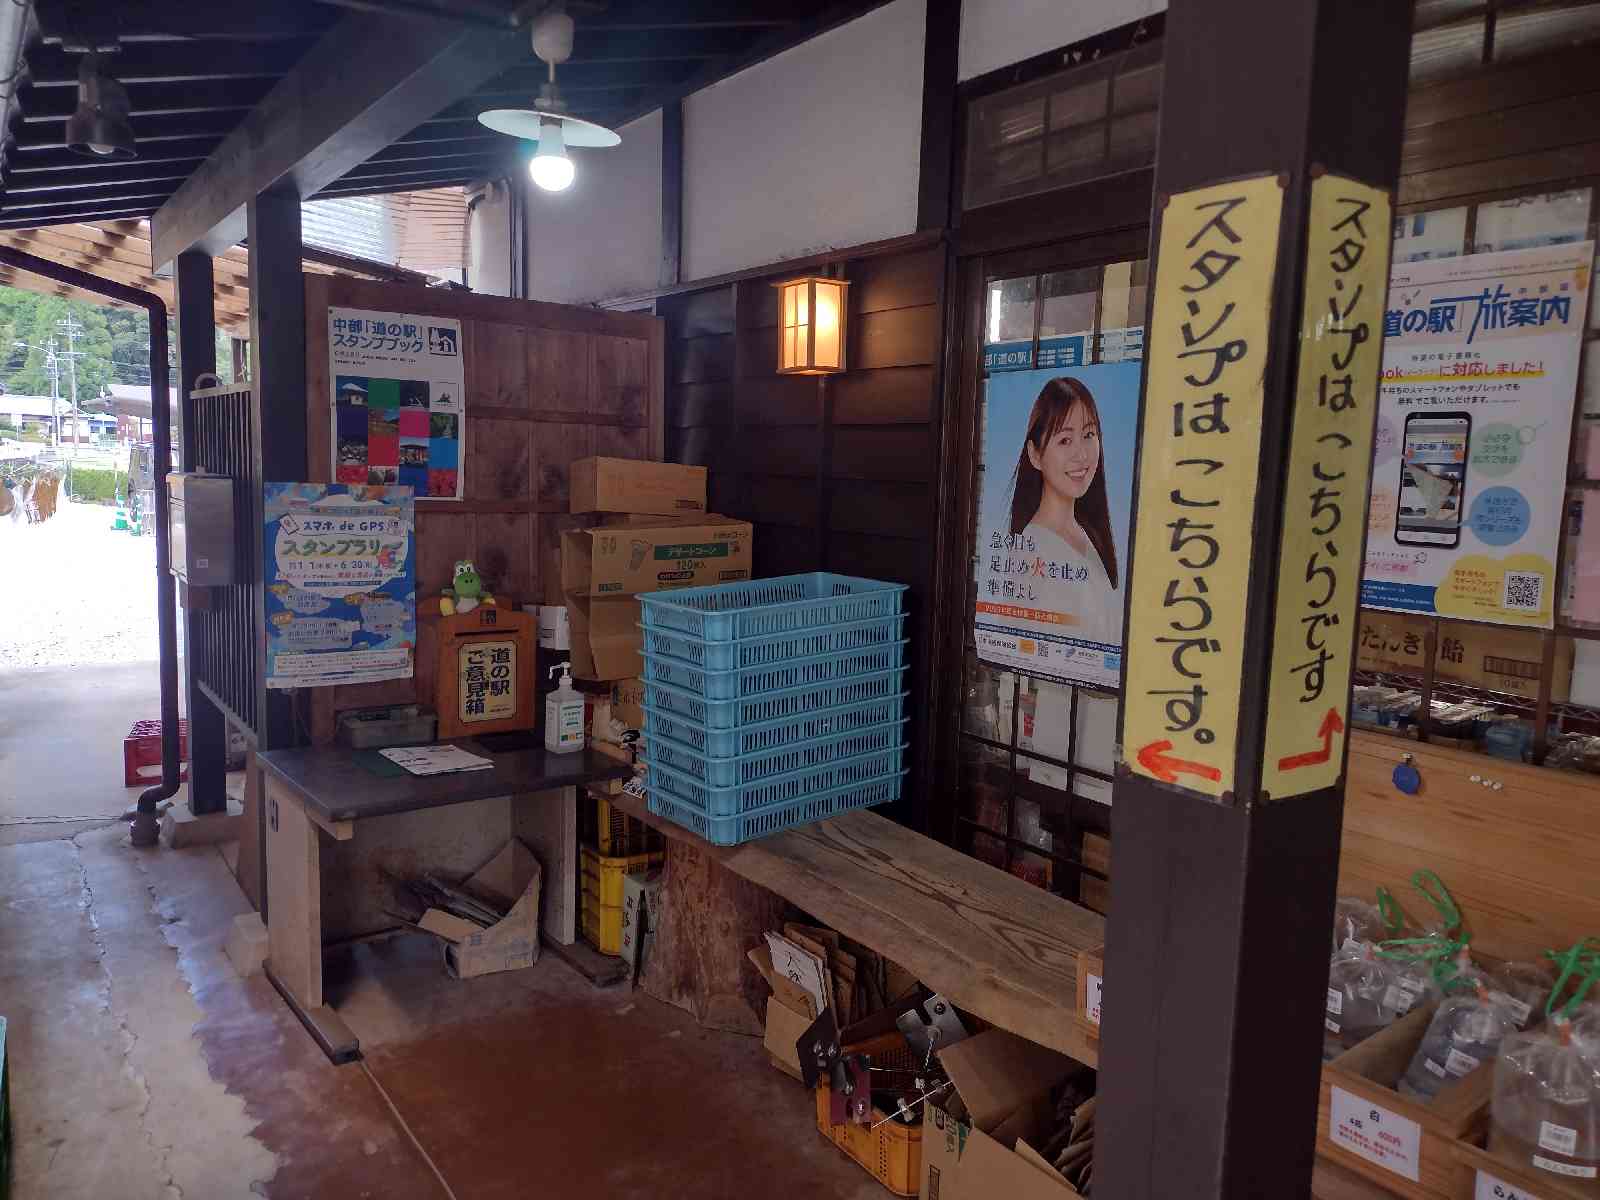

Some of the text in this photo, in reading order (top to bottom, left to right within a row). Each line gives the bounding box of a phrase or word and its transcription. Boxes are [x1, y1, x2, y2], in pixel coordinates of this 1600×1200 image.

[1147, 196, 1248, 745] スタンプはこちらです。
[1291, 196, 1370, 703] スタンプはこちらです
[359, 521, 385, 532] GPS
[986, 577, 1038, 601] 準備よし
[465, 649, 486, 716] ご意見箱
[490, 647, 511, 697] 道の駅
